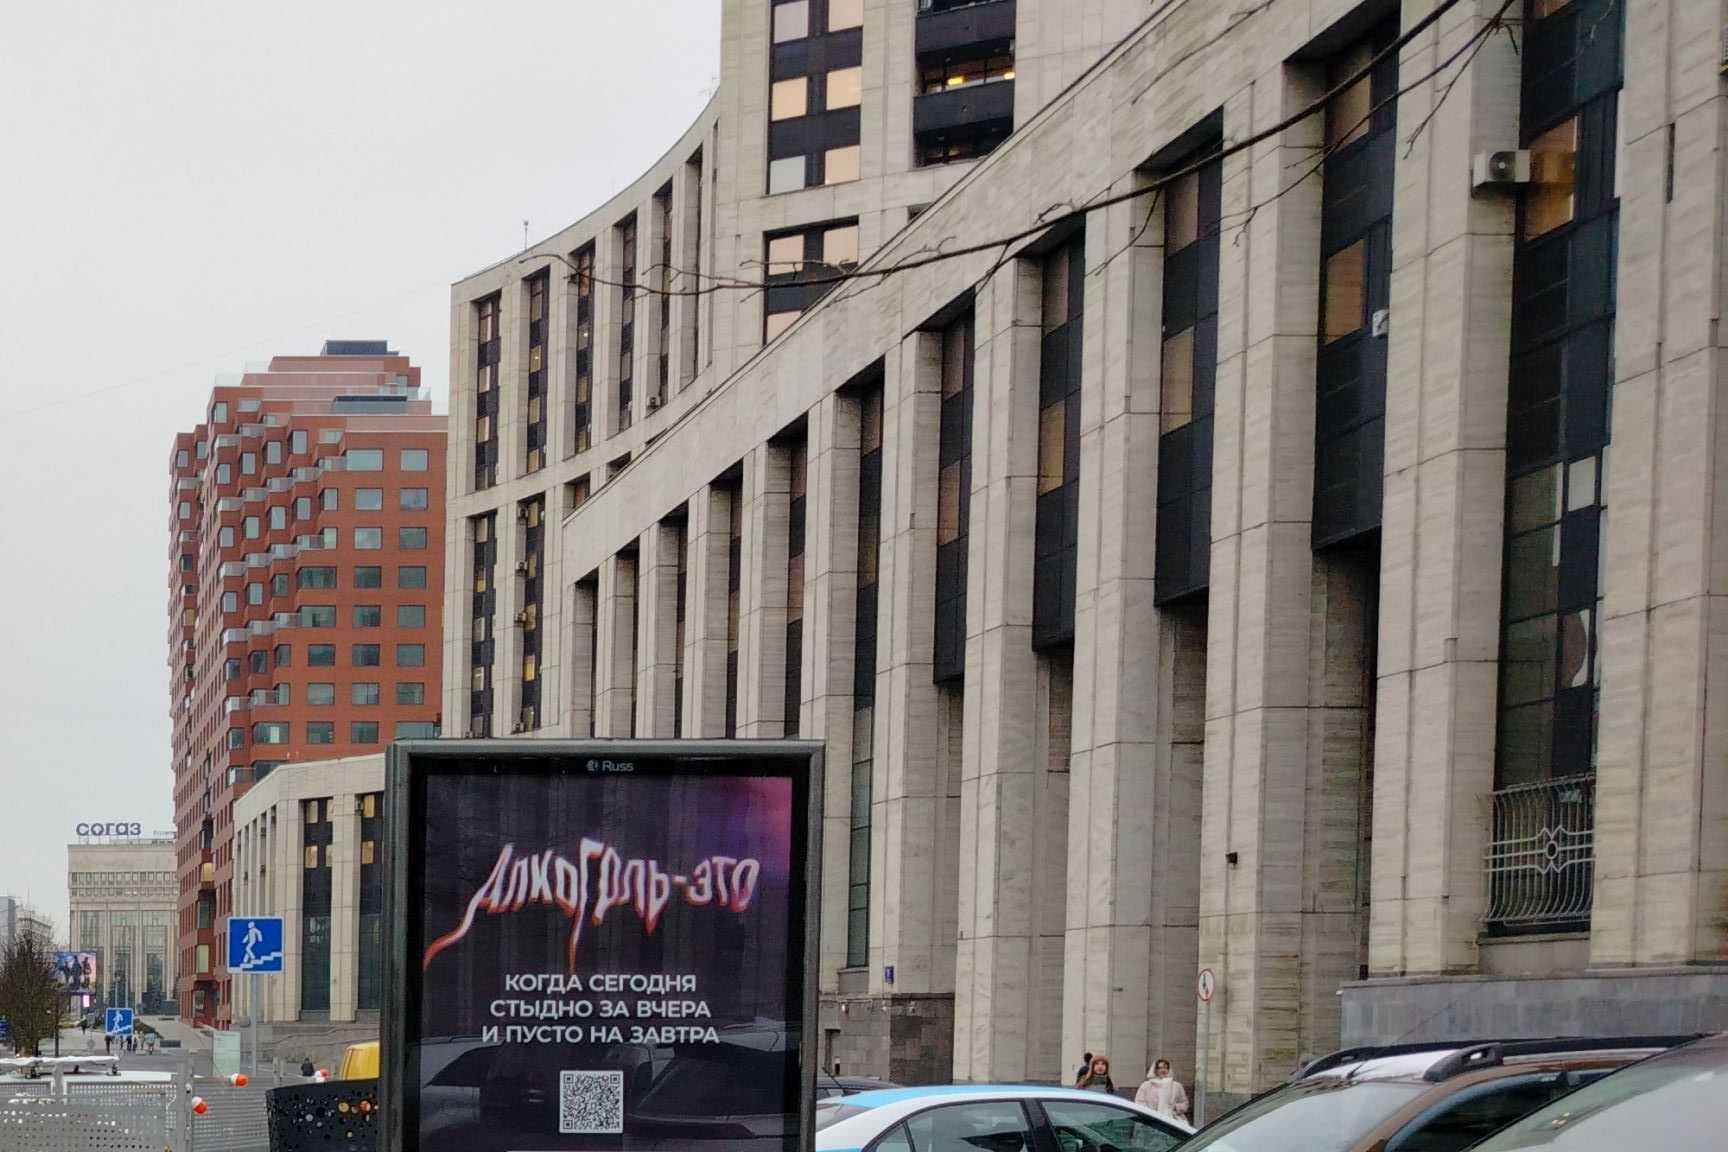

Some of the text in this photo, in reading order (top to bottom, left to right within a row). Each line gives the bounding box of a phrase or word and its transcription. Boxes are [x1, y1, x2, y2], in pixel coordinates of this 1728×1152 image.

[602, 760, 634, 772] Russ
[75, 822, 142, 836] согаз
[505, 974, 697, 994] КОГДА СЕГОДНЯ
[489, 1000, 712, 1020] СТЫДНО ЗА ВЧЕРА
[481, 1025, 721, 1044] И ПУСТО НА ЗАВТРА
